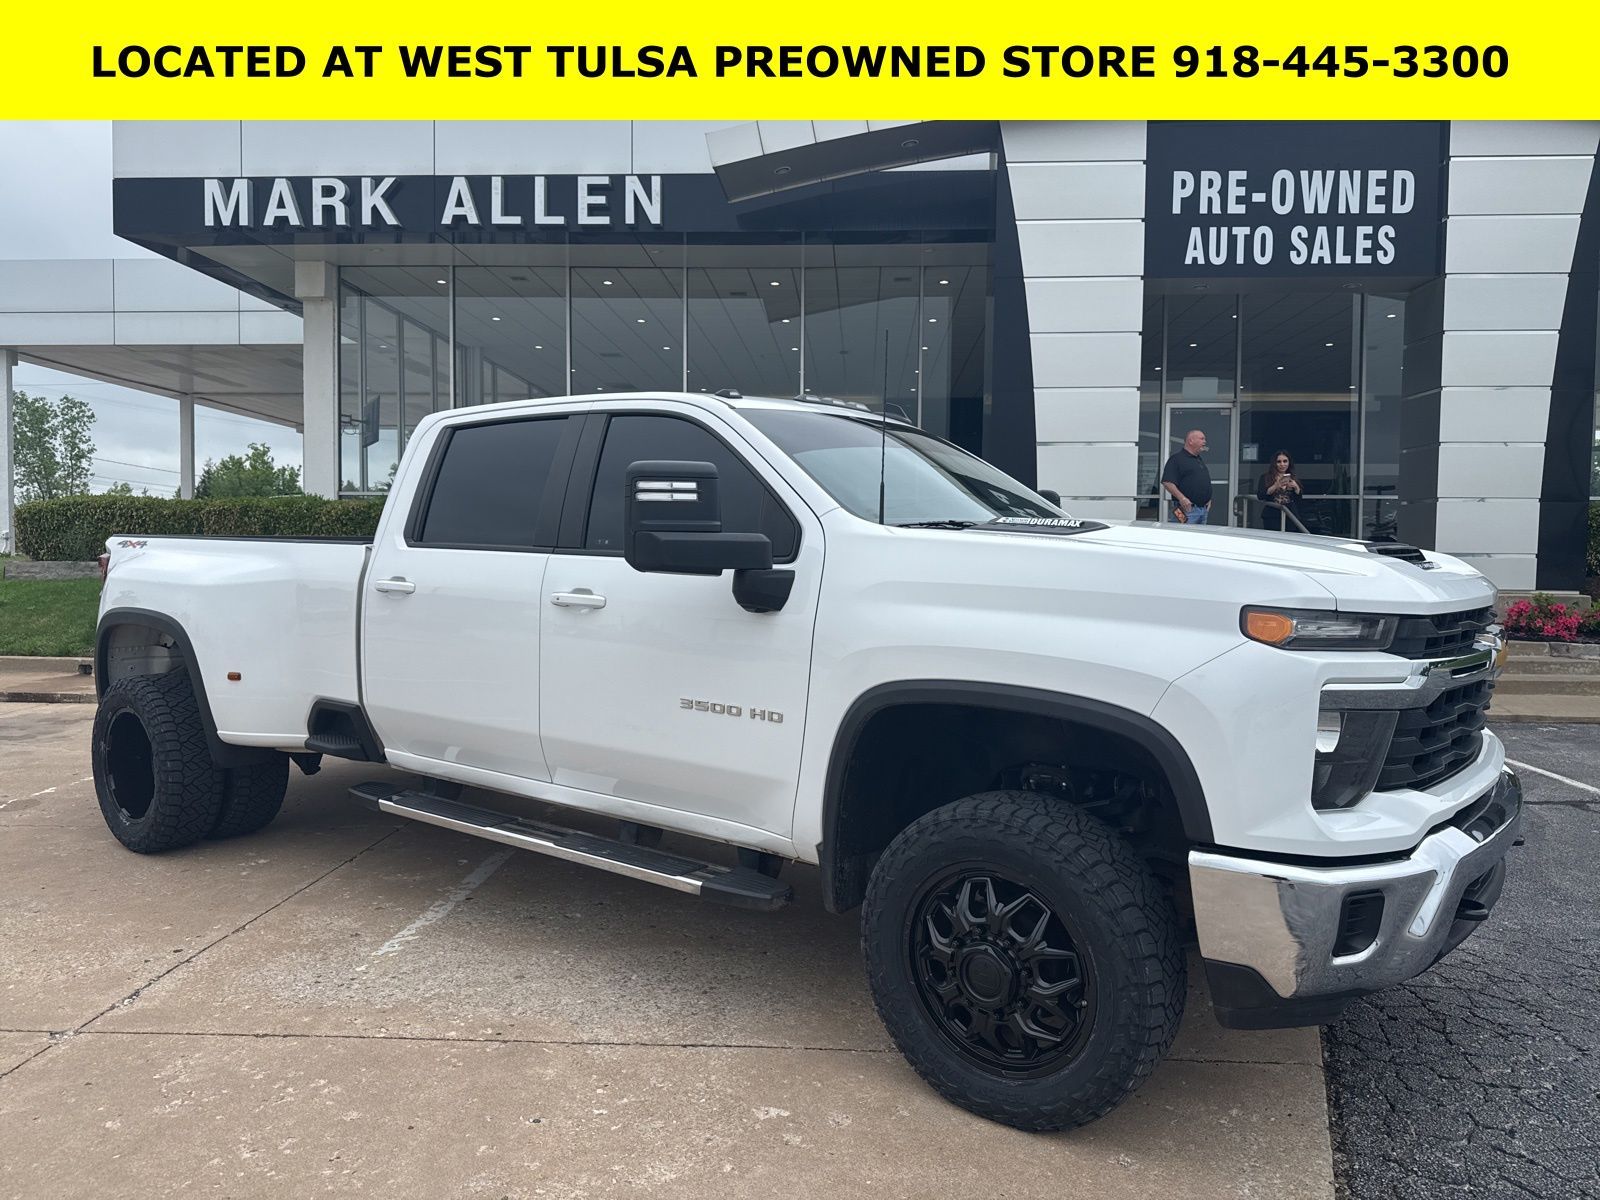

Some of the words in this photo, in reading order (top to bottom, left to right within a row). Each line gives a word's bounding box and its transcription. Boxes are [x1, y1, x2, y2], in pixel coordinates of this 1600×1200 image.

[203, 177, 400, 227] MARK
[440, 175, 664, 226] ALLEN
[1171, 169, 1416, 215] PRE-OWNED
[1184, 225, 1274, 266] AUTO
[1289, 224, 1396, 265] SALES
[1029, 518, 1081, 528] DURAMAX
[679, 698, 742, 717] 3500
[749, 707, 784, 724] HD
